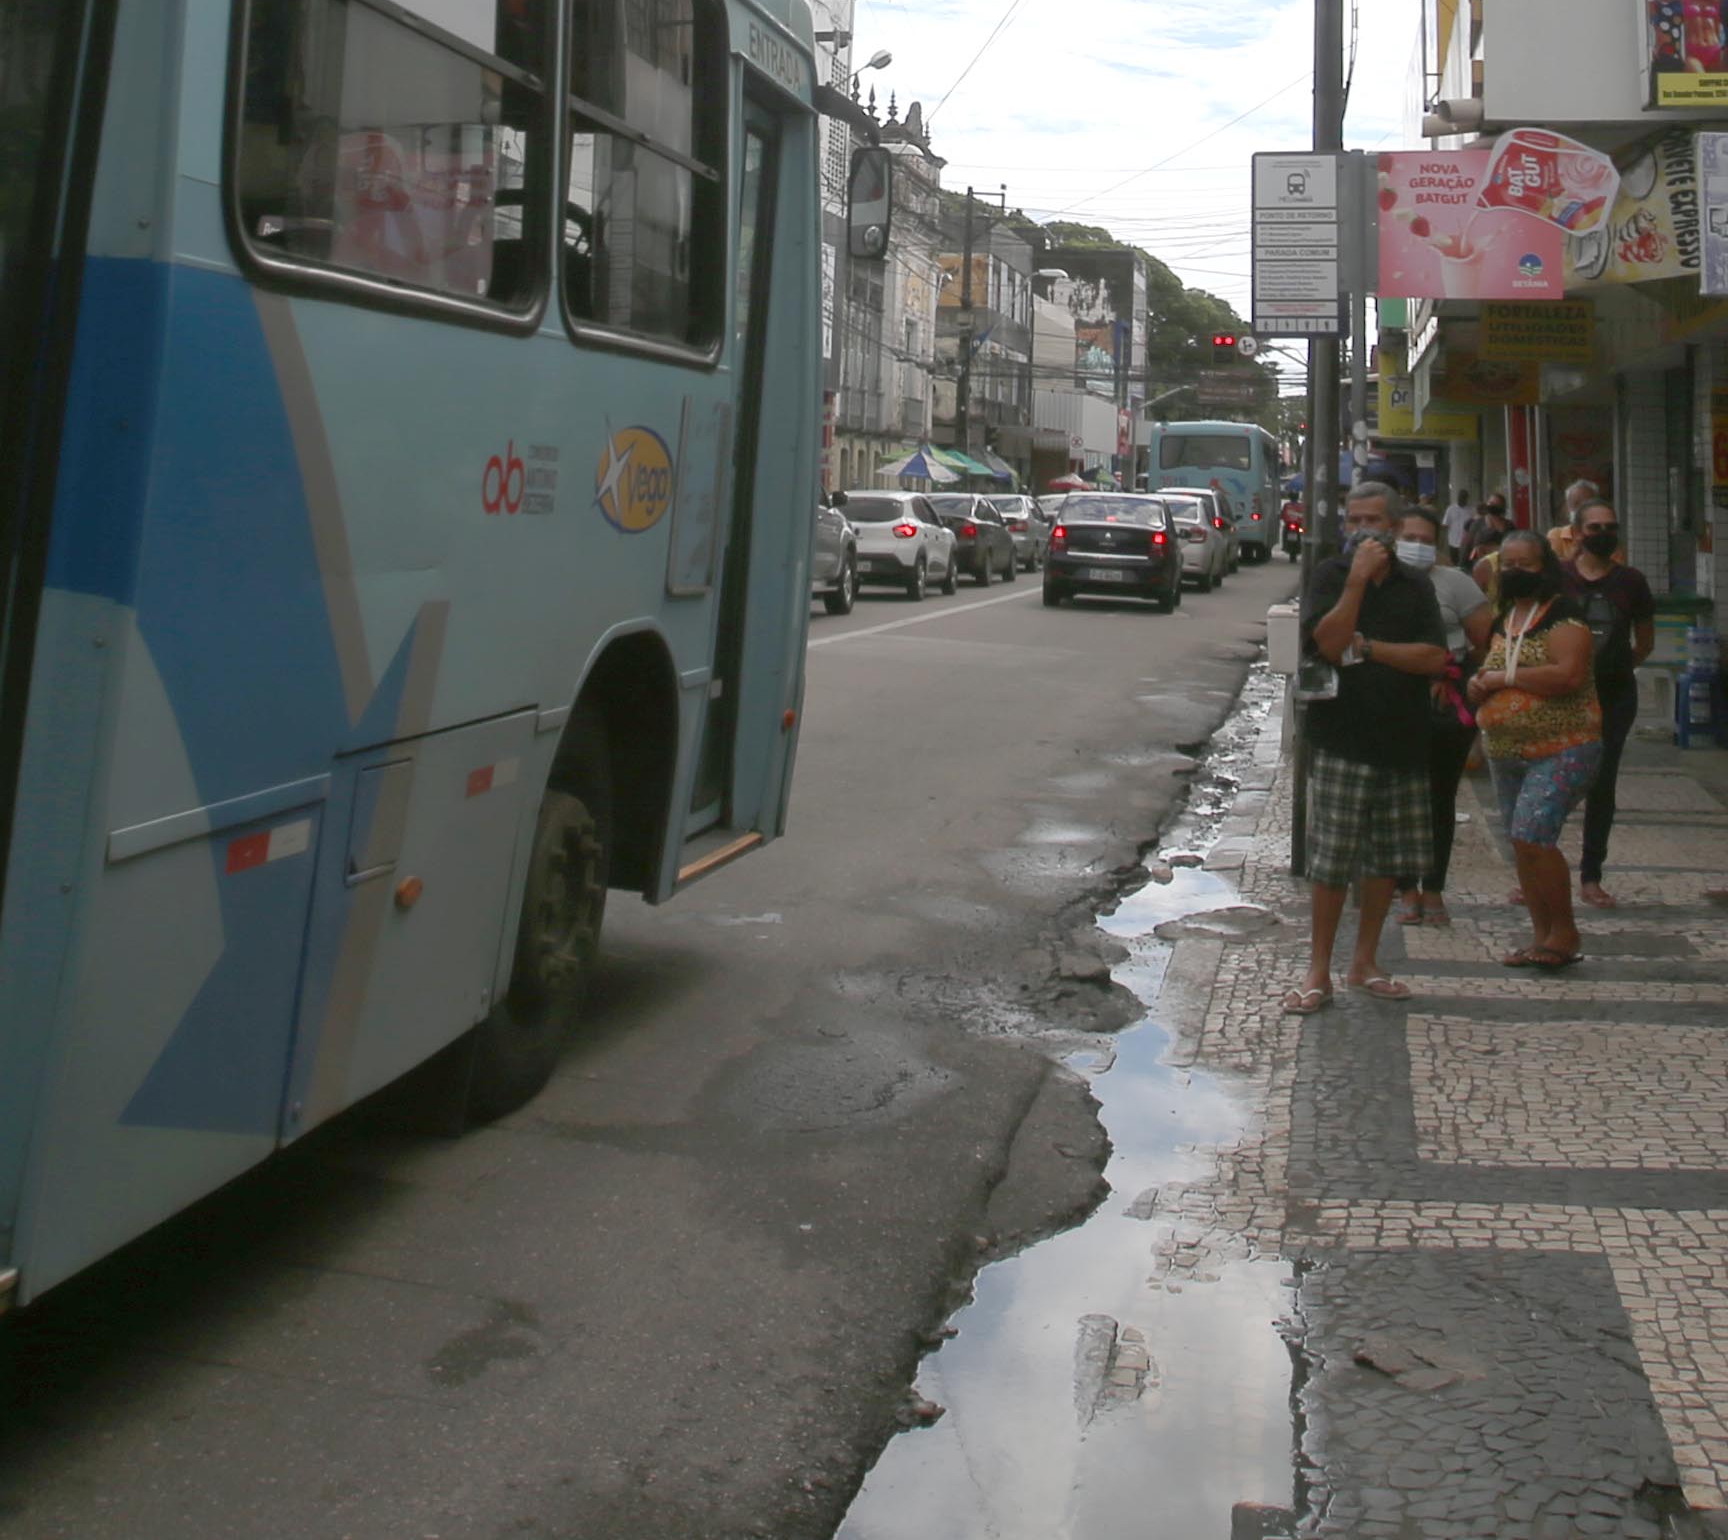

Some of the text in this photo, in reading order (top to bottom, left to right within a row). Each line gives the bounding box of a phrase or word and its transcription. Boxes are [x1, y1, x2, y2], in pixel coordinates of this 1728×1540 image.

[749, 21, 801, 92] ENTRADA
[1420, 163, 1460, 175] NOVA
[1521, 152, 1542, 188] GUT
[1409, 174, 1475, 189] GERAÇÃO
[1507, 166, 1525, 197] BAT
[1415, 192, 1468, 205] BATGUT
